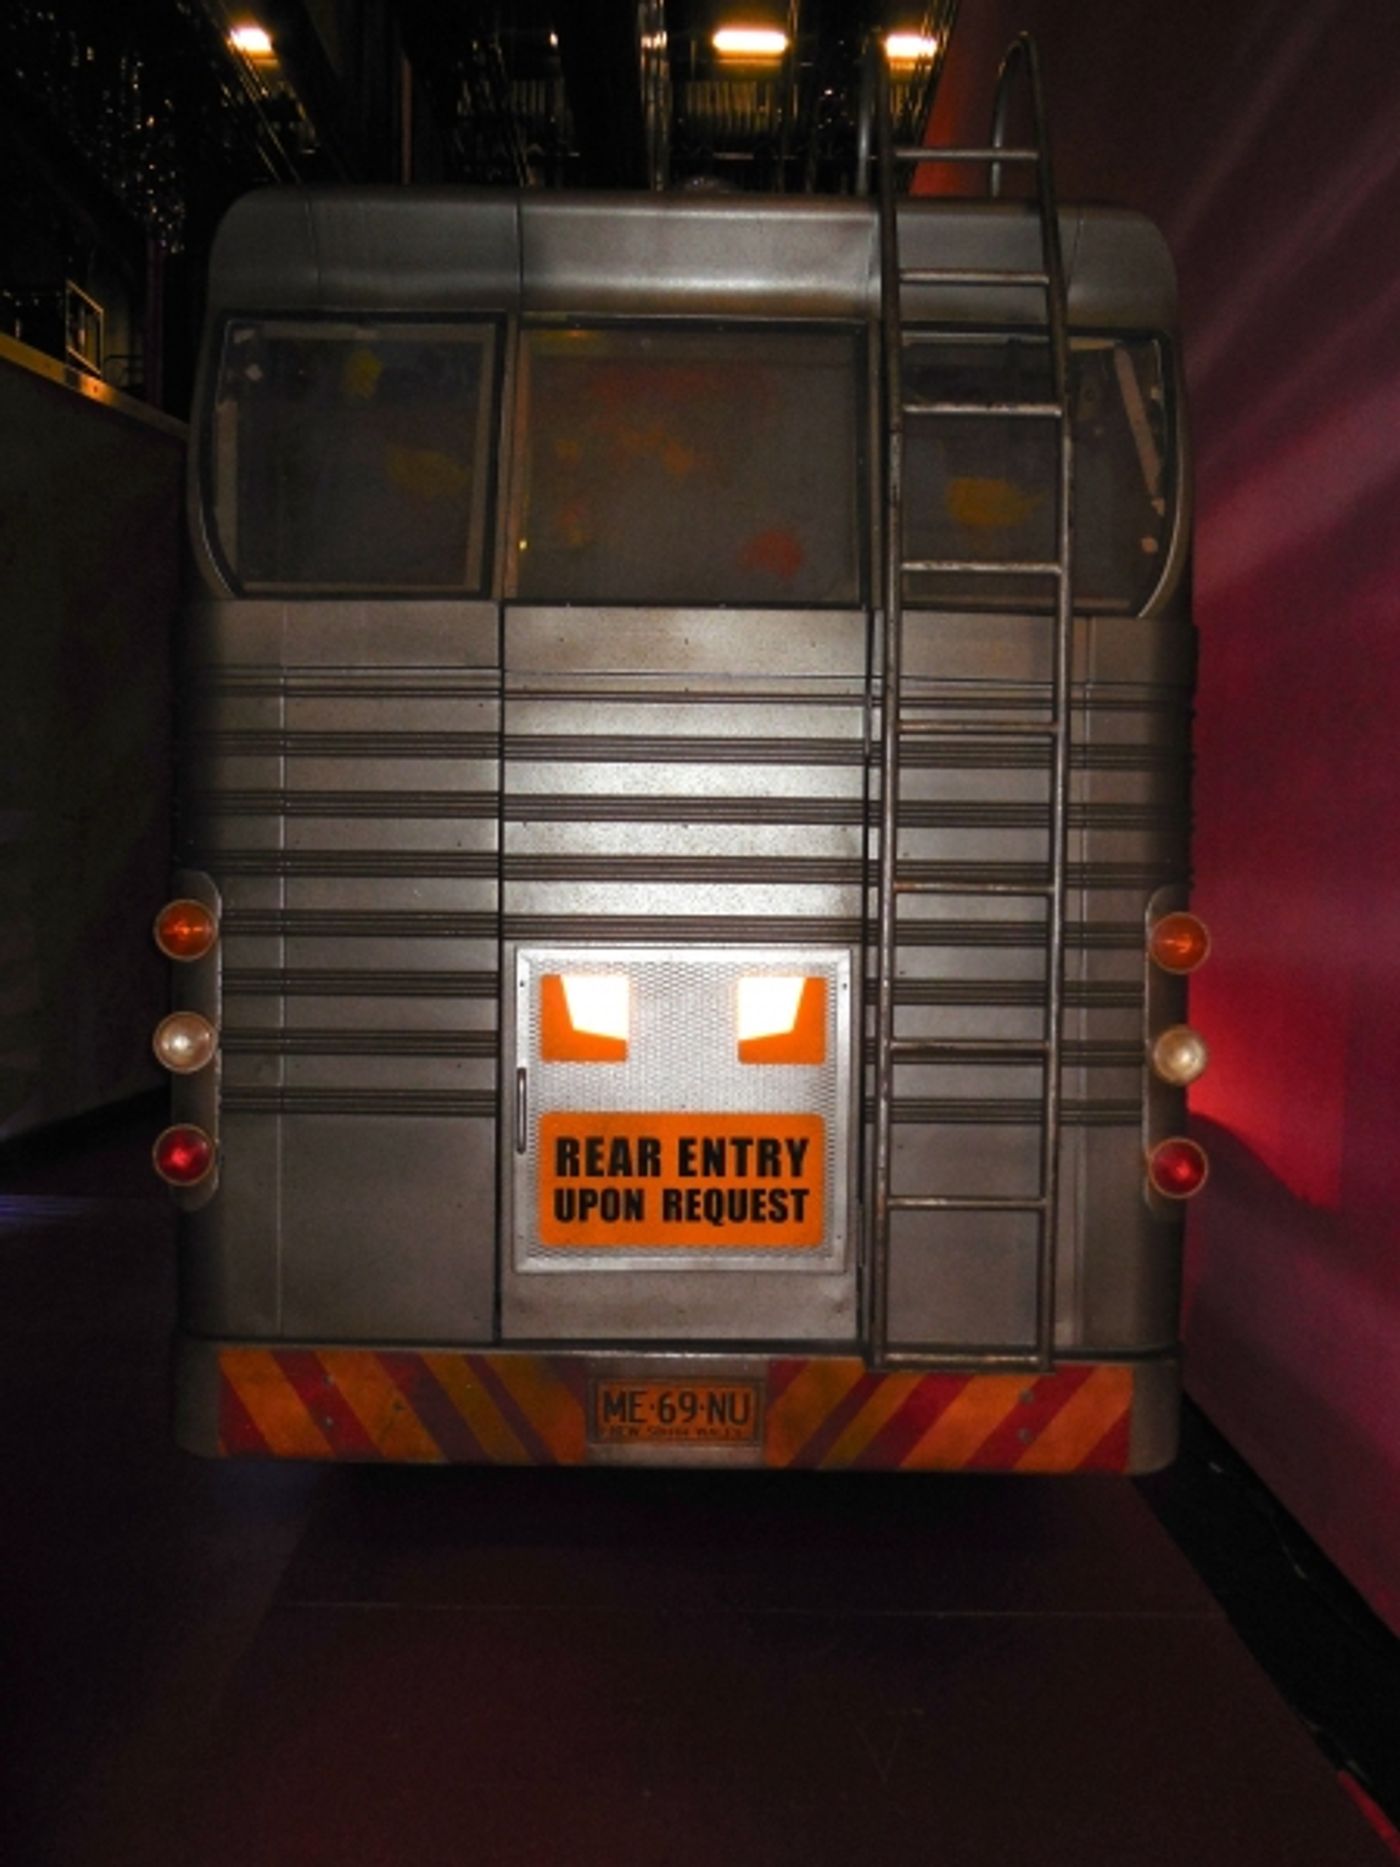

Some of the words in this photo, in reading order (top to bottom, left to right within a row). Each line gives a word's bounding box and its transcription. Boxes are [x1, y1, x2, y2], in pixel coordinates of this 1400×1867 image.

[556, 1136, 661, 1177] REAR
[678, 1137, 809, 1177] ENTRY
[554, 1188, 644, 1222] UPON
[663, 1188, 810, 1226] REQUEST
